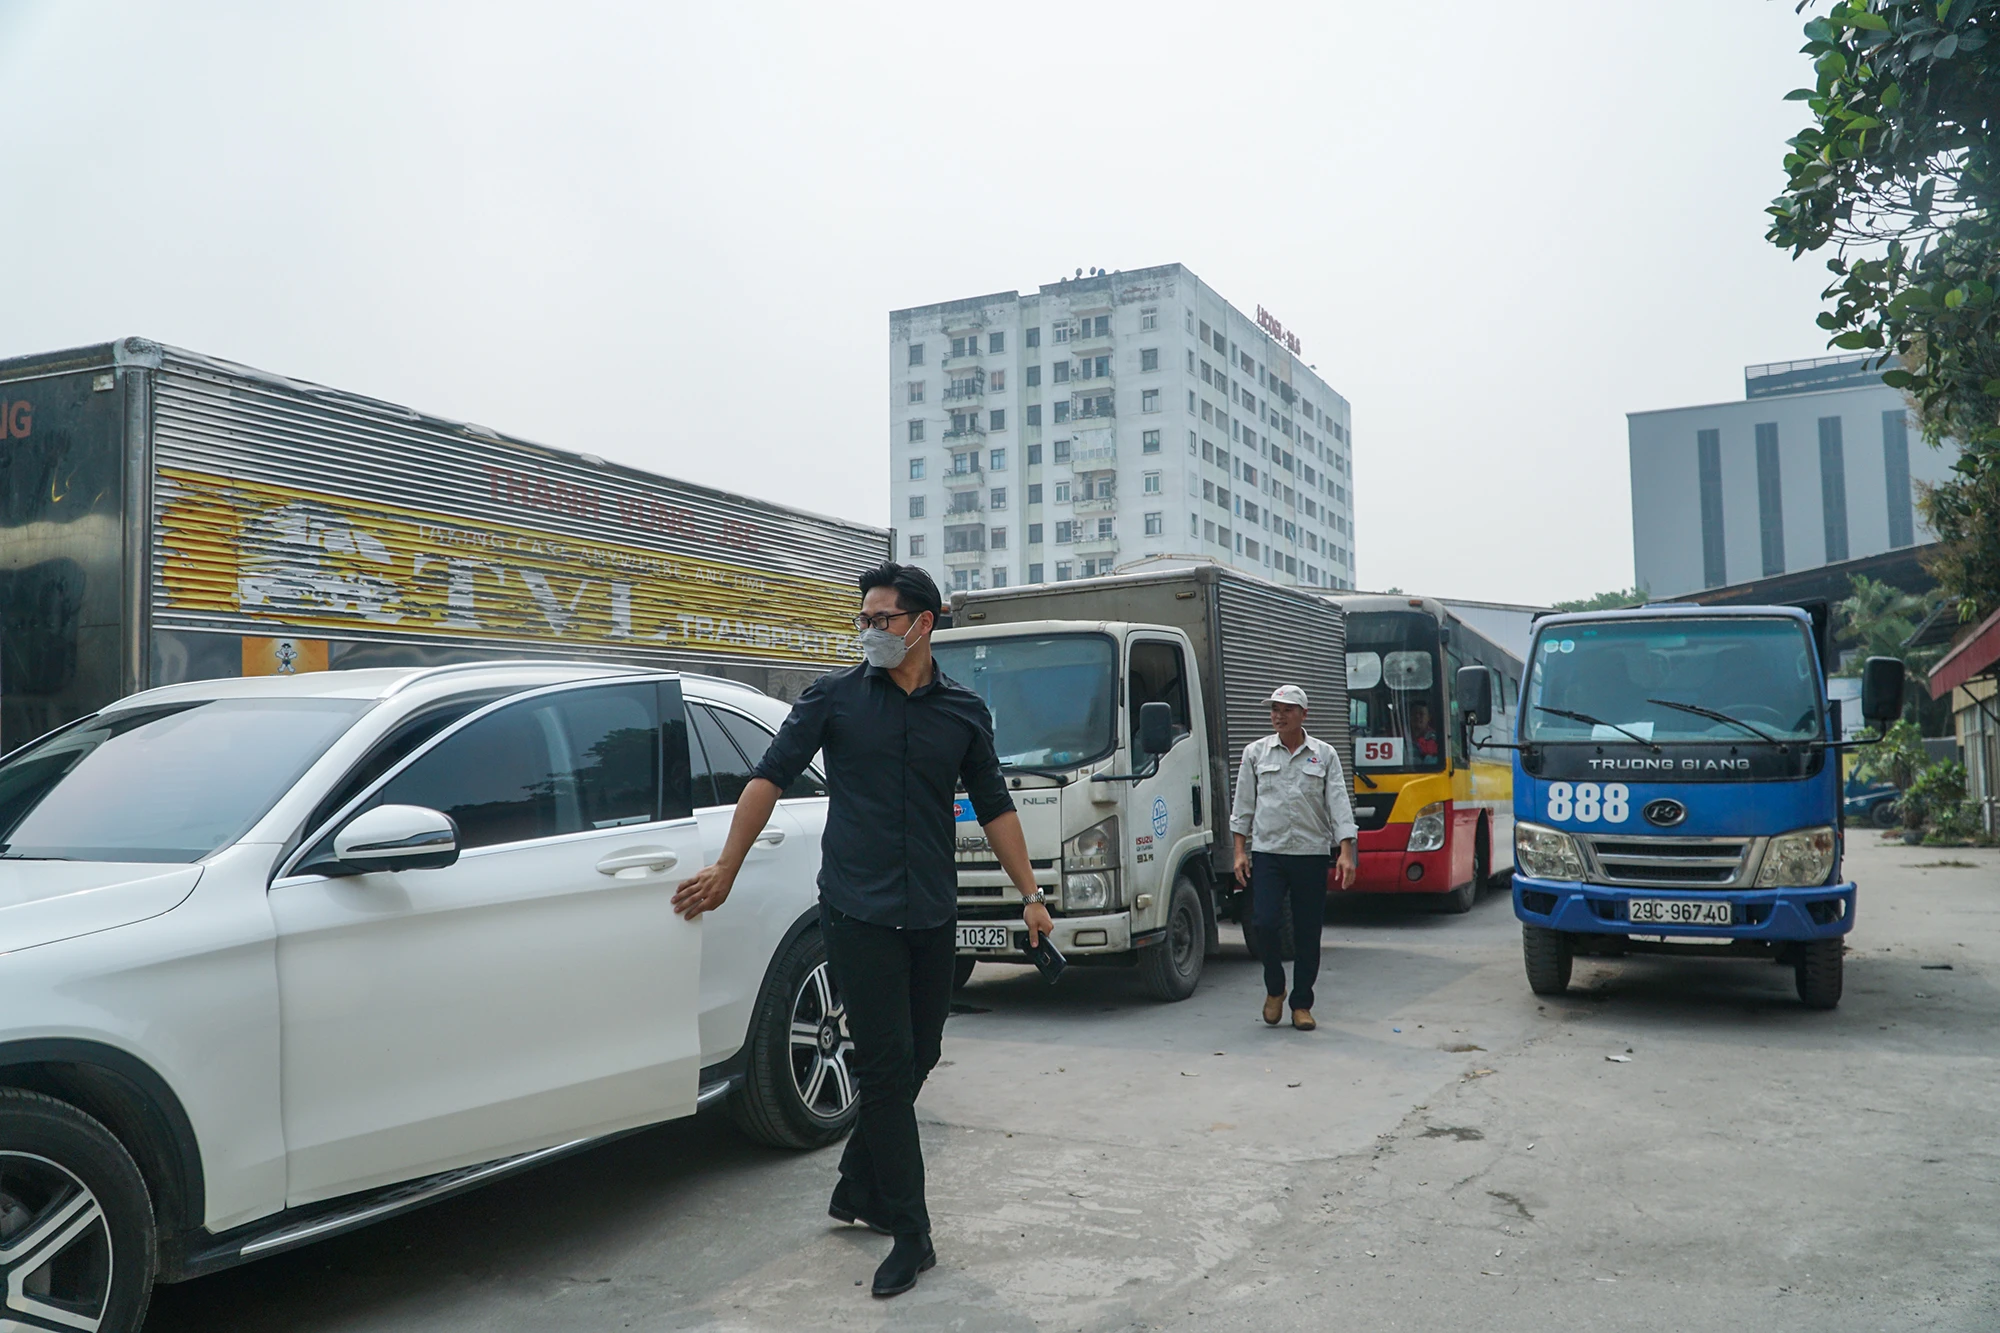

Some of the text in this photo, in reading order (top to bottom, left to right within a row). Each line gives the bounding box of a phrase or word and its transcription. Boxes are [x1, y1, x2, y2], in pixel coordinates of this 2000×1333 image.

[716, 518, 760, 550] JSC
[695, 566, 727, 582] ANY
[413, 552, 669, 640] TVL
[1365, 742, 1393, 760] 59
[1589, 759, 1750, 770] TRUONG GIANG
[1023, 797, 1058, 806] NLR
[1547, 781, 1630, 824] 888
[1136, 835, 1153, 845] ISUZU
